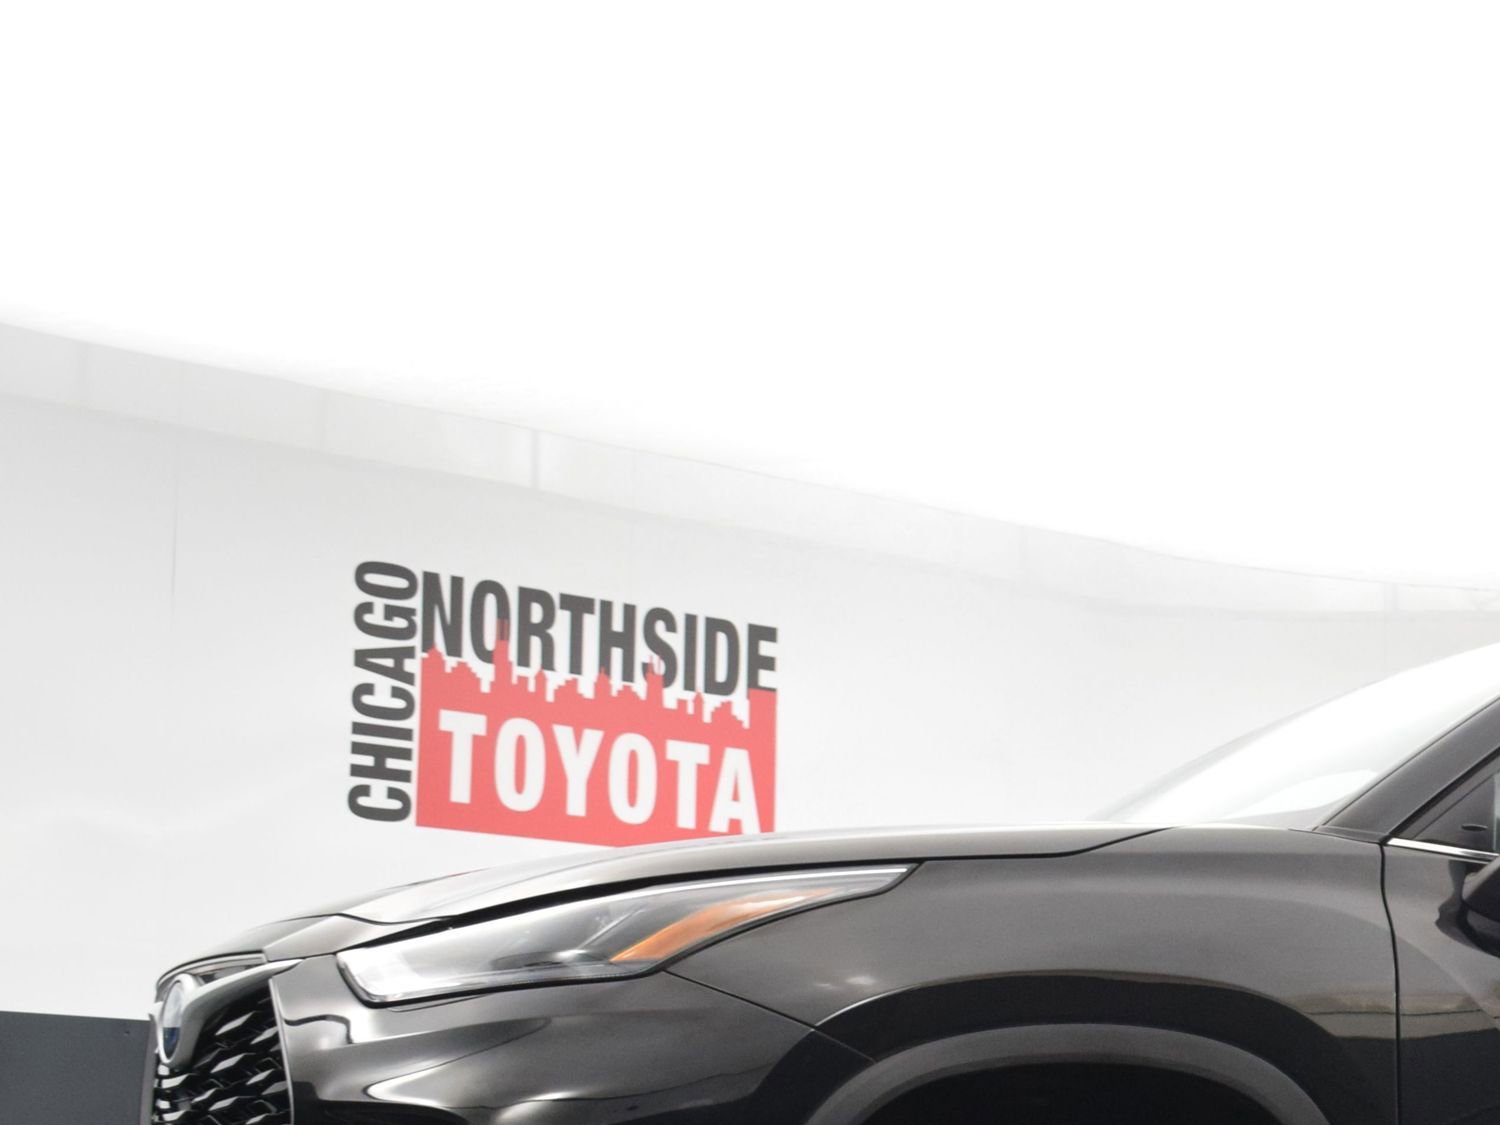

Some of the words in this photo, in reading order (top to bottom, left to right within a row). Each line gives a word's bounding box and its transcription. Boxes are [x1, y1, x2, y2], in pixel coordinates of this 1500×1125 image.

[347, 560, 418, 823] CHICAGO
[421, 570, 778, 697] NORTHSIDE
[438, 708, 761, 834] TOYOTA
